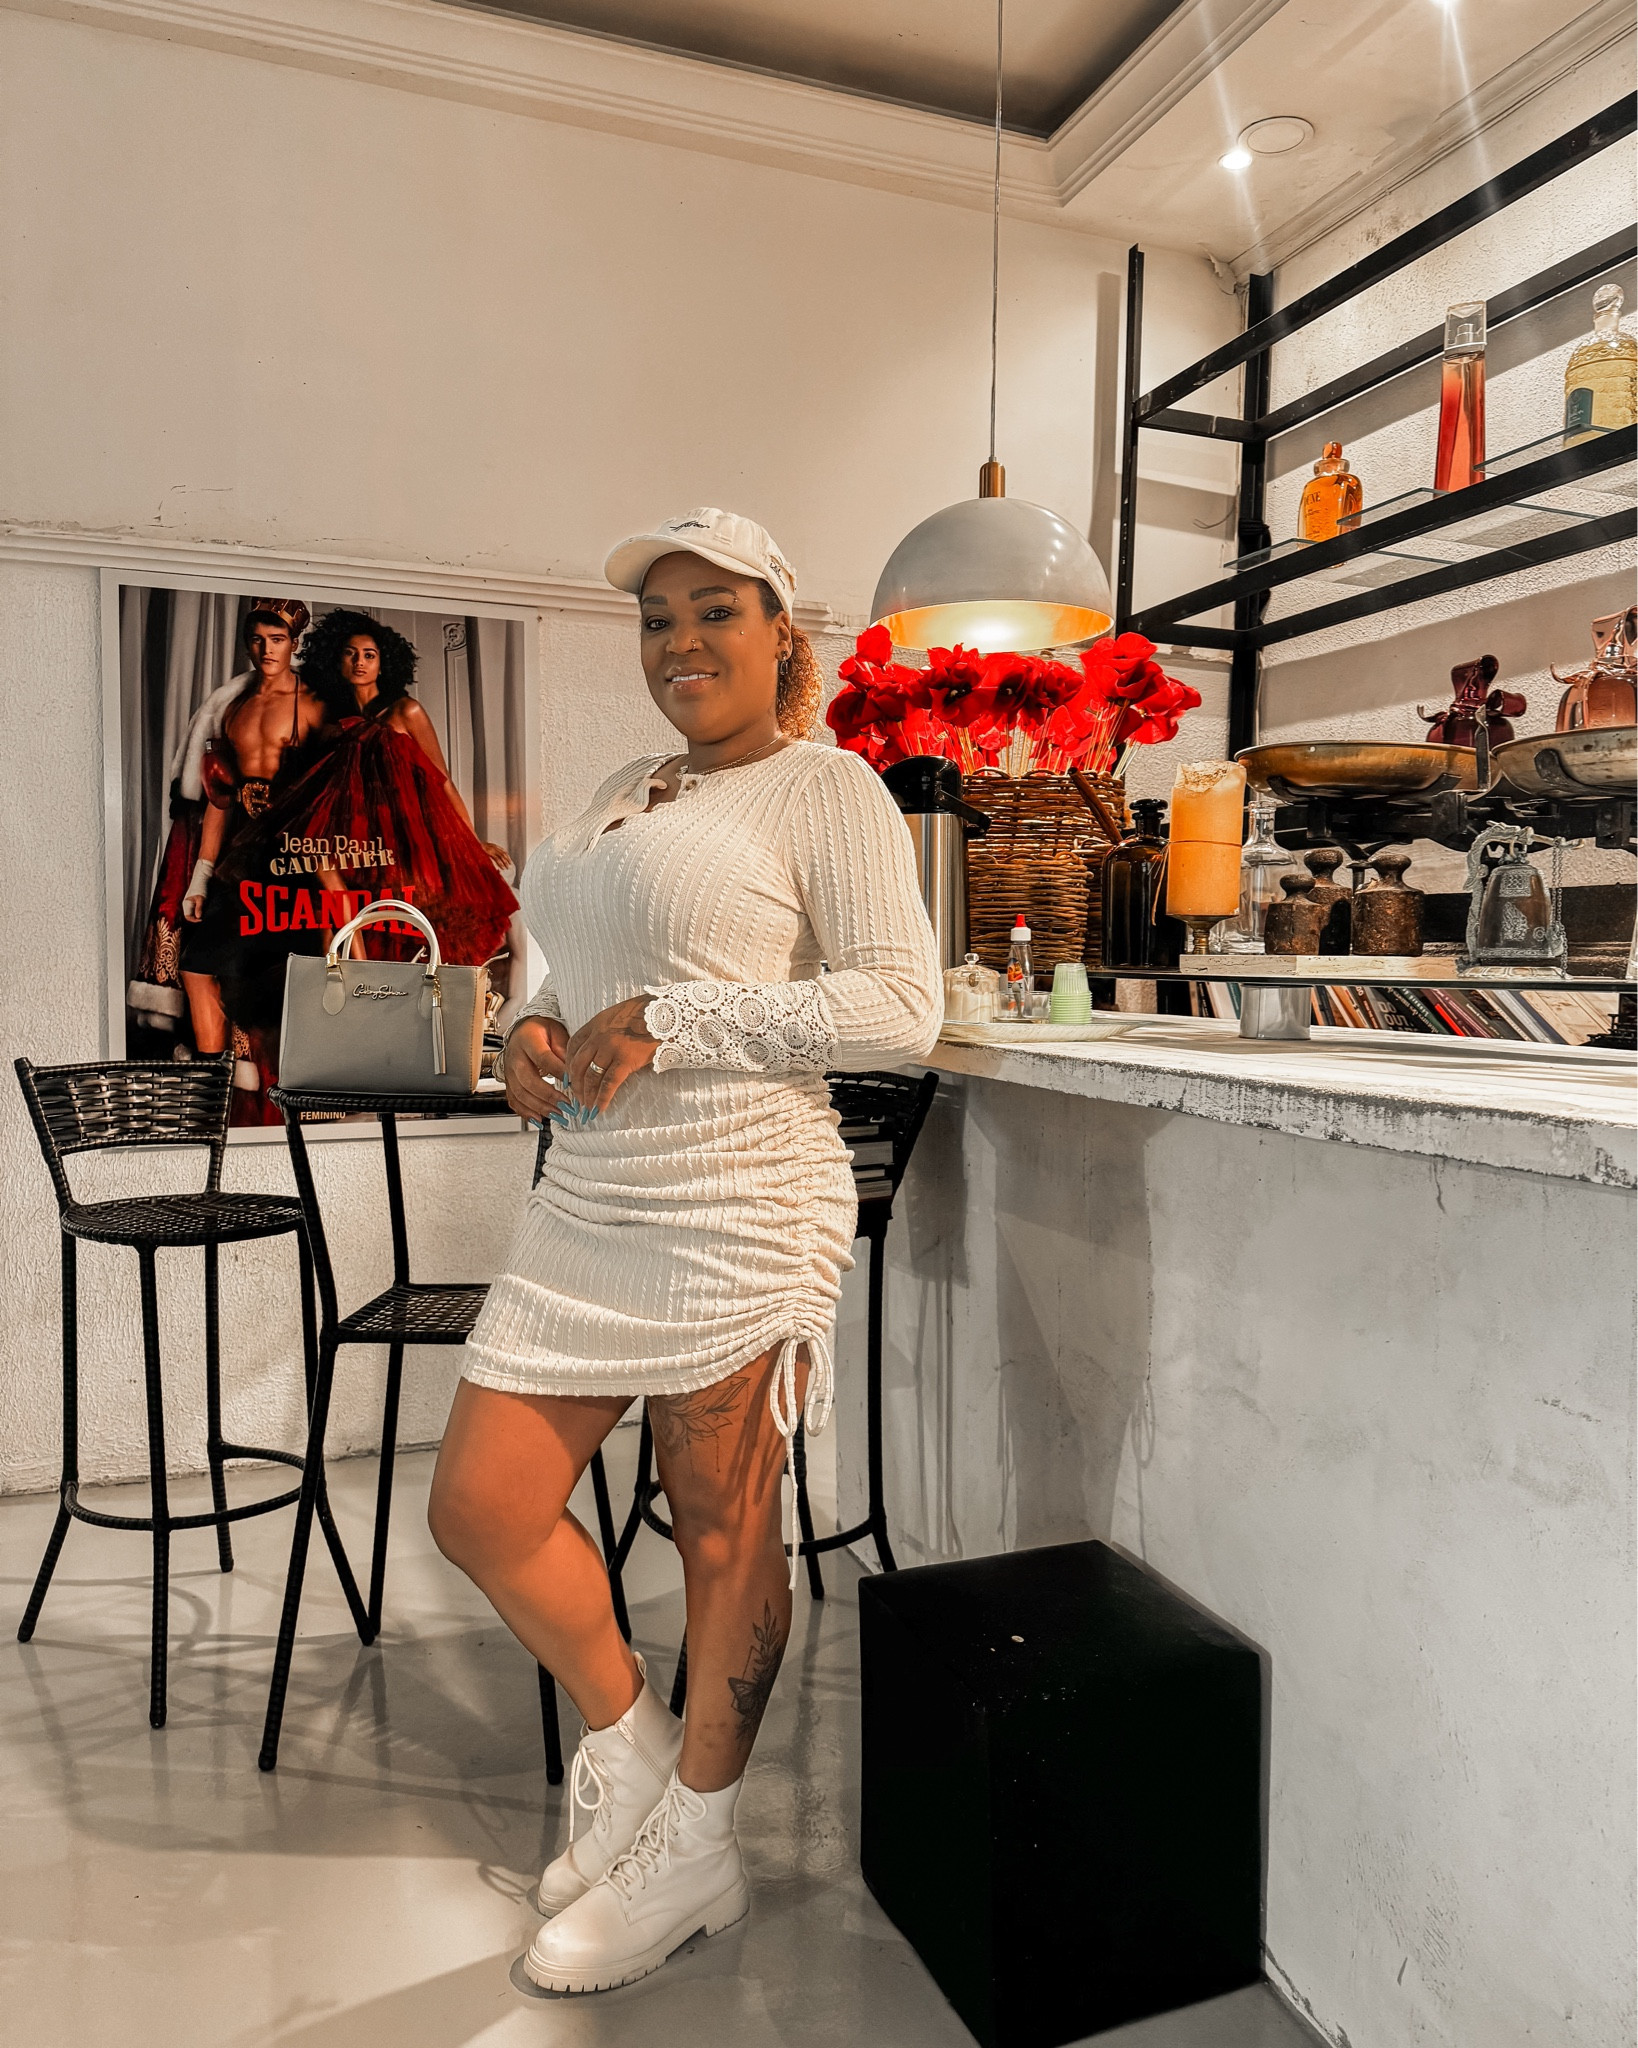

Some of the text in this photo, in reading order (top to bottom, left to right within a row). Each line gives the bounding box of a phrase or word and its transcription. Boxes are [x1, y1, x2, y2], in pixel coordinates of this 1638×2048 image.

[280, 832, 383, 854] Jean Paul
[270, 848, 396, 876] GAULTIER
[239, 880, 426, 938] SCANDAL
